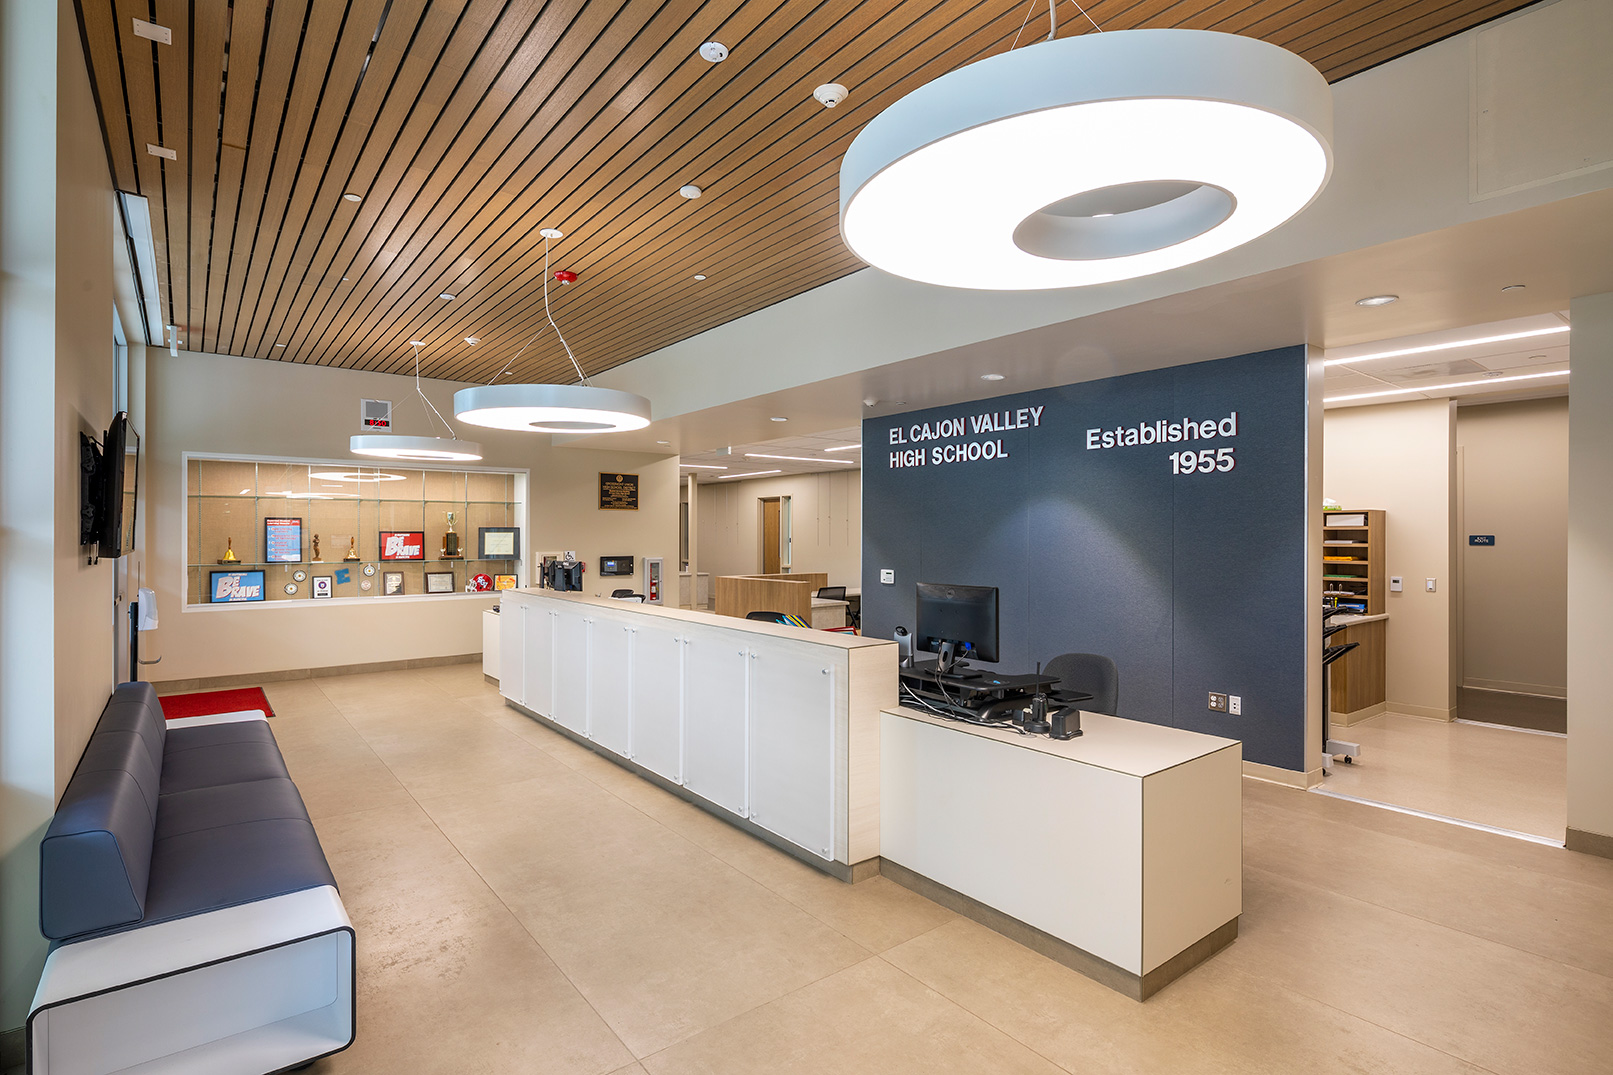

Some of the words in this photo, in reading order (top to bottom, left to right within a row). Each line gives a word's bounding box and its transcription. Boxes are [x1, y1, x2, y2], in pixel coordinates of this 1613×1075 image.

[889, 427, 908, 445] EL
[909, 417, 966, 443] CAJON
[970, 405, 1045, 434] VALLEY
[1086, 411, 1238, 450] Established
[889, 448, 926, 469] HIGH
[931, 439, 1009, 466] SCHOOL
[1169, 447, 1236, 475] 1955
